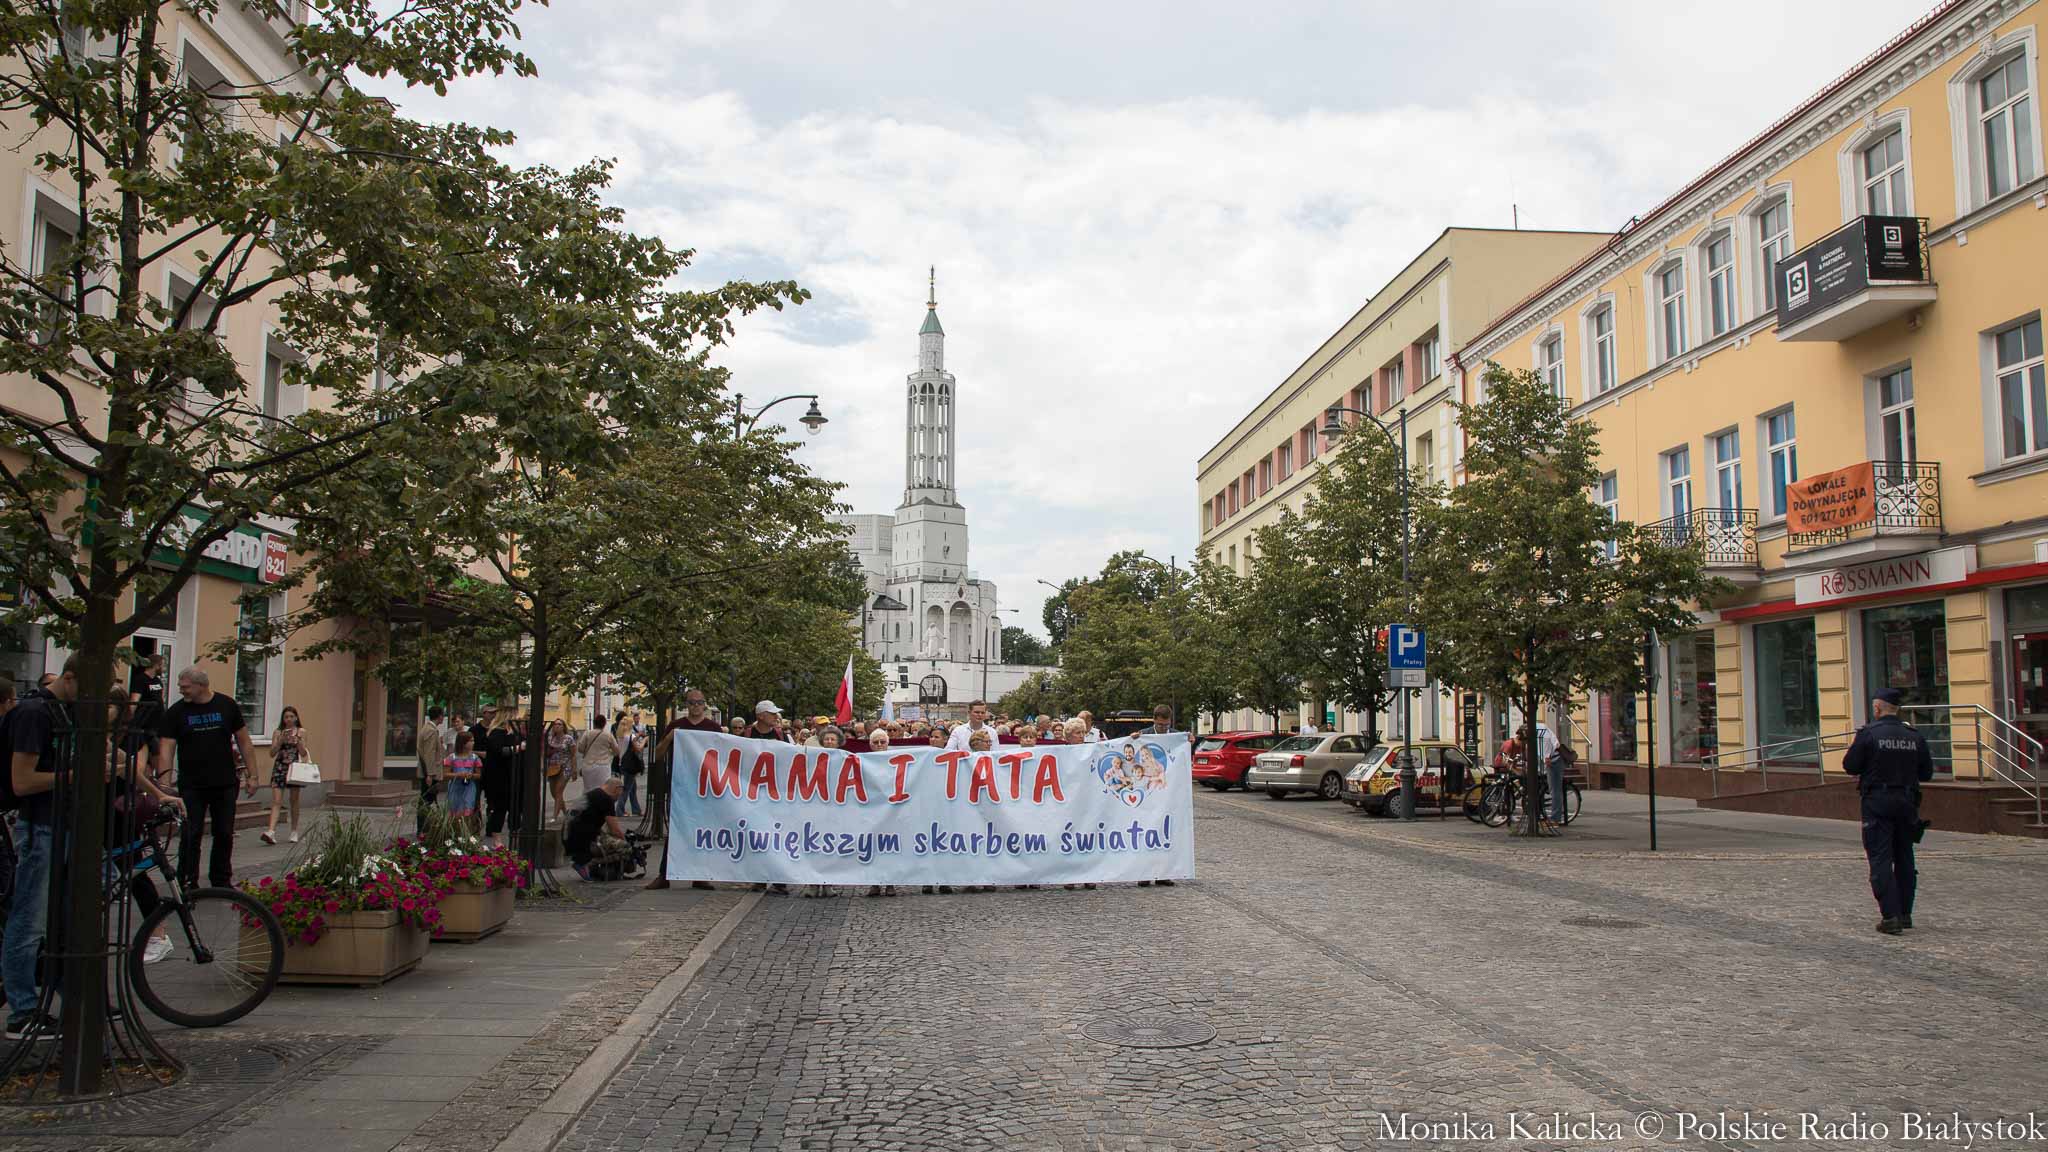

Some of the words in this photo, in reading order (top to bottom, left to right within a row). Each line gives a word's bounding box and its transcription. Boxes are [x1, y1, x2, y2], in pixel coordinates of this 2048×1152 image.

[1808, 477, 1846, 494] LOKALE
[1801, 512, 1818, 524] 601
[1820, 509, 1837, 521] 277
[1840, 504, 1857, 518] 011
[267, 541, 288, 552] czynne
[1821, 558, 1931, 596] ROSSMANN
[1398, 628, 1418, 656] P
[1879, 739, 1917, 751] POLICJA
[698, 748, 869, 804] MAMA
[888, 753, 915, 803] I
[935, 750, 1065, 803] TATA
[696, 819, 900, 863] największym
[914, 821, 1047, 856] skarbem
[1060, 814, 1171, 853] świata!
